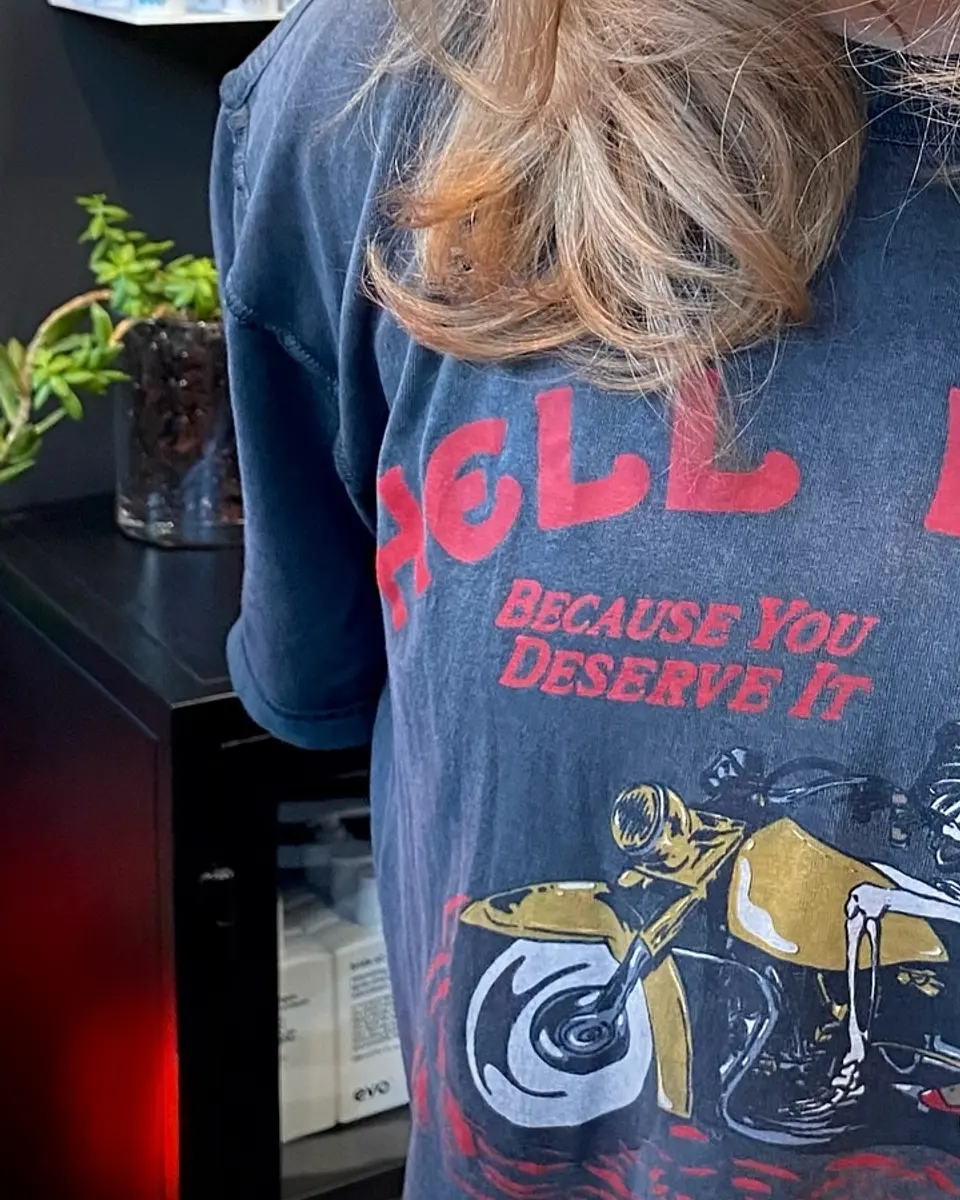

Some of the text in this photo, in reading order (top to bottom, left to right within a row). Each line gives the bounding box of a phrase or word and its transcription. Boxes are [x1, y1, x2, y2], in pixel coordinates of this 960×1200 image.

[376, 368, 799, 631] HELL
[495, 578, 880, 657] BECAUSE YOU
[499, 634, 873, 721] DESERVE IT
[353, 1079, 391, 1102] evo
